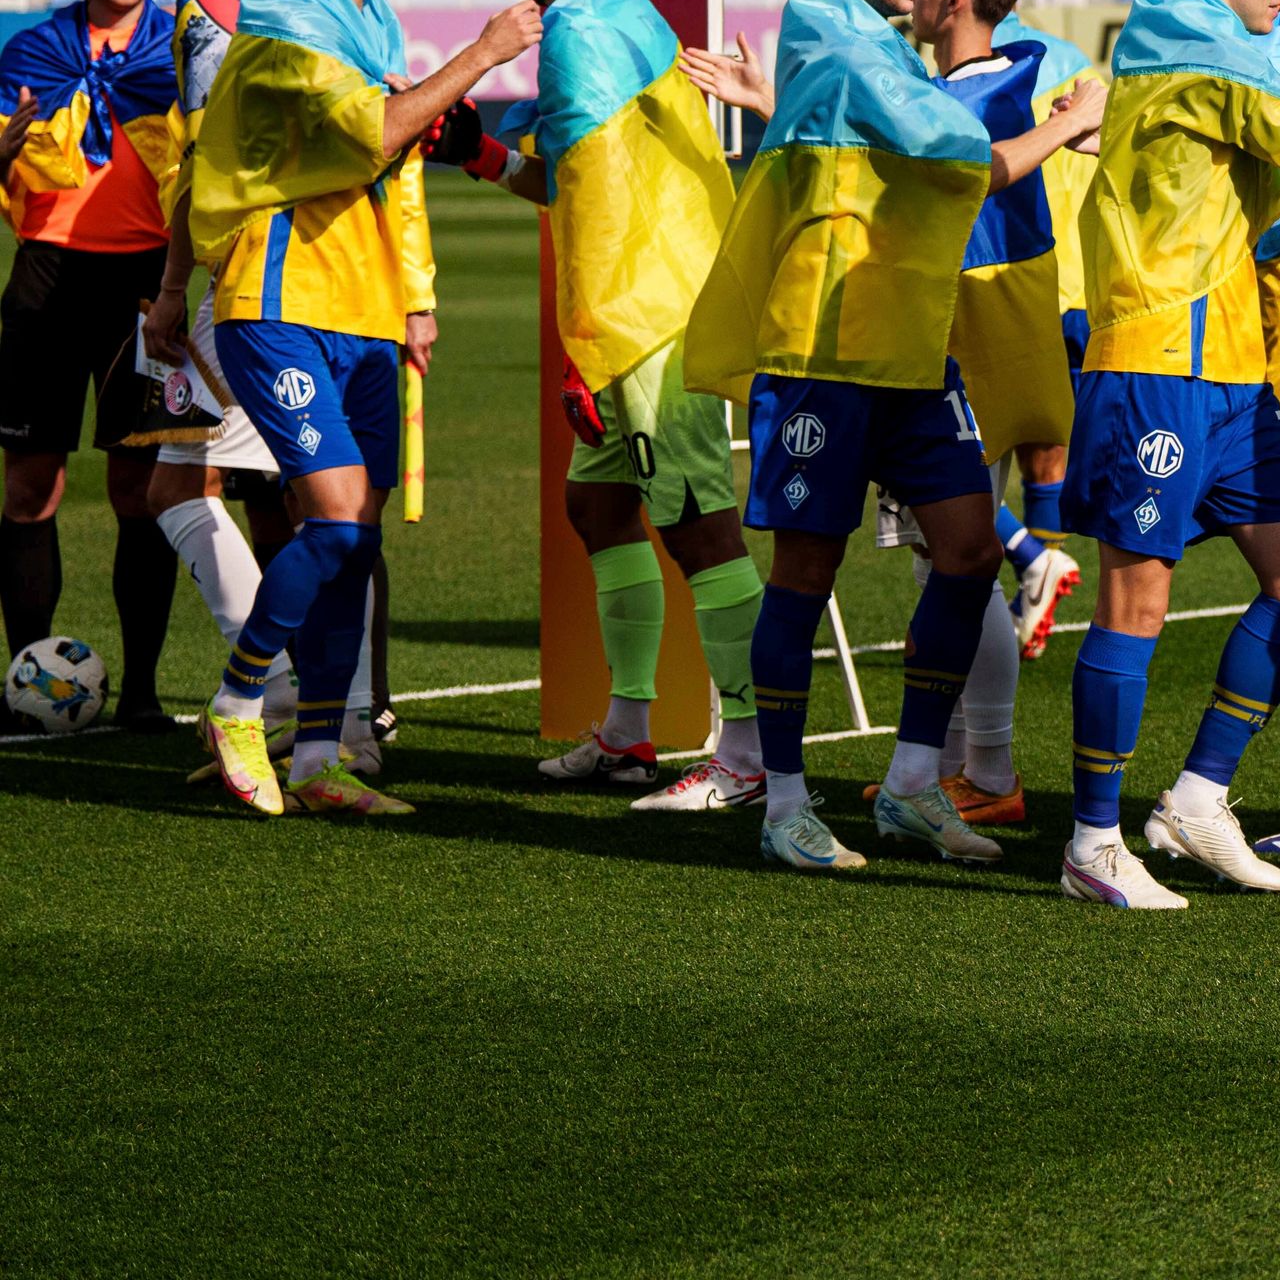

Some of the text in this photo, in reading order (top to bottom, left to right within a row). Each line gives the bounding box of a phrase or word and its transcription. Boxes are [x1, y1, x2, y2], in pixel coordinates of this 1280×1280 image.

[275, 370, 312, 407] MG
[785, 416, 823, 455] MG
[1139, 433, 1181, 476] MG
